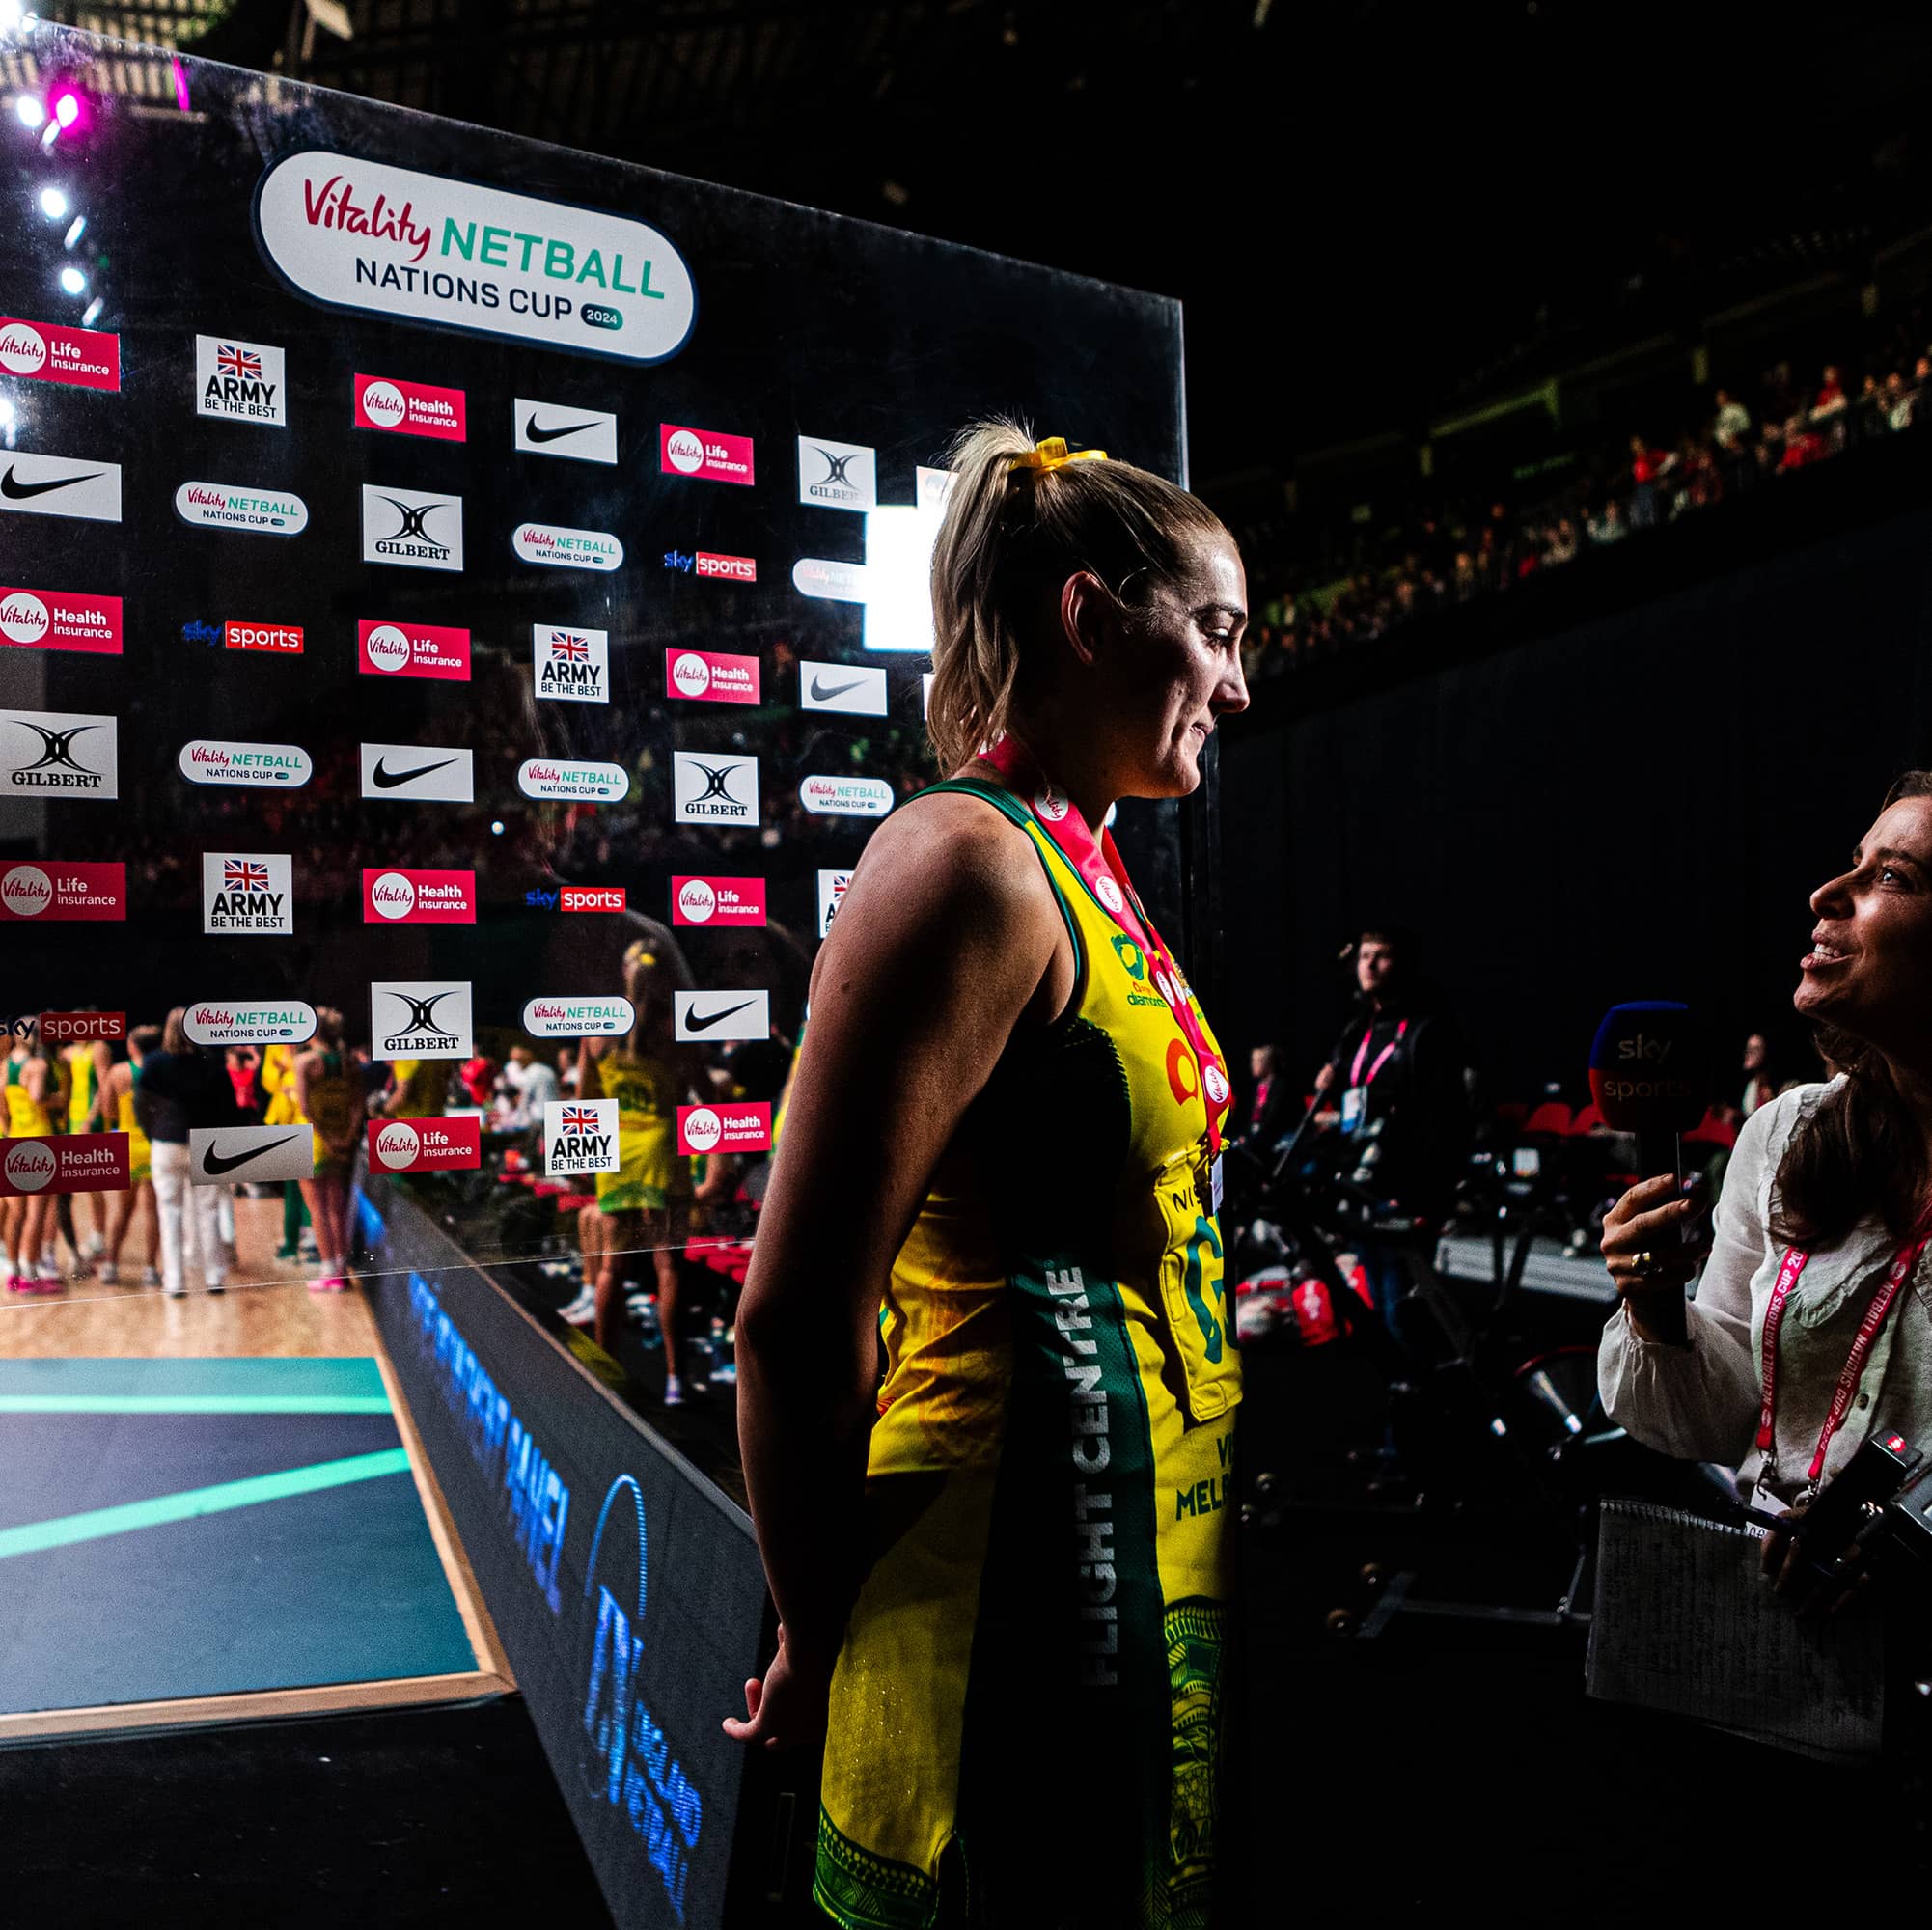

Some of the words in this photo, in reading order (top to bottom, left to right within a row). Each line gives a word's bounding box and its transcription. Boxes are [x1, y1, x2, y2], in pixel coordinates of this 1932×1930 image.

[304, 175, 430, 262] Vitality
[441, 217, 664, 299] NETBALL
[356, 258, 499, 308] NATIONS
[510, 289, 572, 319] CUP
[587, 309, 618, 325] 2024
[50, 341, 81, 358] Life
[50, 356, 109, 375] insurance
[206, 375, 276, 405] ARMY
[205, 398, 219, 410] BE
[222, 400, 245, 414] THE
[248, 404, 277, 418] BEST
[365, 392, 403, 417] Vitality
[409, 398, 453, 415] Health
[409, 411, 458, 427] insurance
[670, 440, 702, 462] Vitality
[706, 444, 728, 458] Life
[706, 457, 747, 472] insurance
[187, 487, 225, 510] Vitality
[228, 497, 298, 516] NETBALL
[810, 485, 858, 502] GILBE
[203, 510, 245, 523] NATIONS
[248, 515, 268, 524] CUP
[375, 541, 450, 560] GILBERT
[523, 529, 555, 549] Vitality
[557, 538, 615, 554] NETBALL
[536, 549, 571, 561] NATIONS
[573, 554, 591, 563] CUP
[664, 549, 694, 572] sky
[699, 557, 753, 576] sports
[0, 604, 47, 630] Vitality
[54, 608, 106, 625] Health
[54, 623, 113, 639] insurance
[183, 620, 222, 646] sky
[230, 627, 298, 648] sports
[370, 636, 408, 659] Vitality
[413, 639, 439, 653] Life
[413, 653, 462, 667] insurance
[541, 661, 600, 685] ARMY
[676, 664, 707, 683] Vitality
[712, 666, 749, 680] Health
[541, 682, 553, 693] BE
[556, 683, 575, 694] THE
[577, 685, 601, 696] BEST
[712, 678, 753, 692] insurance
[191, 746, 229, 767] Vitality
[232, 754, 302, 768] NETBALL
[11, 771, 101, 788] GILBERT
[207, 768, 250, 779] NATIONS
[252, 770, 272, 779] CUP
[528, 764, 560, 784] Vitality
[562, 771, 621, 785] NETBALL
[540, 785, 577, 794] NATIONS
[838, 786, 886, 799] NETBALL
[685, 803, 748, 816] GILBERT
[819, 799, 850, 808] NATIONS
[3, 878, 50, 902] Vitality
[57, 878, 88, 893] Life
[418, 884, 462, 898] Health
[57, 894, 116, 906] insurance
[212, 893, 284, 916] ARMY
[373, 884, 413, 907] Vitality
[418, 898, 467, 910] insurance
[525, 888, 559, 909] sky
[564, 891, 622, 910] sports
[680, 893, 713, 911] Vitality
[718, 890, 739, 903] Life
[718, 903, 759, 914] insurance
[211, 917, 226, 927] BE
[229, 917, 252, 927] THE
[256, 918, 284, 928] BEST
[196, 1007, 234, 1028] Vitality
[235, 1011, 307, 1025] NETBALL
[534, 1004, 566, 1021] Vitality
[566, 1006, 626, 1019] NETBALL
[44, 1017, 121, 1039] sports
[210, 1028, 254, 1038] NATIONS
[257, 1028, 277, 1036] CUP
[545, 1022, 583, 1031] NATIONS
[384, 1037, 459, 1051] GILBERT
[1618, 1034, 1673, 1065] sky
[1604, 1078, 1691, 1102] sports
[686, 1121, 720, 1140] Vitality
[723, 1117, 760, 1129] Health
[423, 1132, 448, 1145] Life
[723, 1128, 764, 1141] insurance
[378, 1135, 418, 1156] Vitality
[423, 1146, 472, 1157] insurance
[553, 1135, 611, 1158] ARMY
[6, 1153, 55, 1178] Vitality
[62, 1149, 114, 1165] Health
[551, 1159, 565, 1170] BE
[566, 1158, 585, 1170] THE
[588, 1156, 612, 1168] BEST
[62, 1165, 120, 1177] insurance
[1787, 1251, 1805, 1269] 20
[1778, 1267, 1794, 1294] CUP
[1864, 1282, 1894, 1333] NETBALL
[1763, 1296, 1782, 1349] NATIONS
[1839, 1333, 1869, 1388] NATIONS
[1045, 1266, 1111, 1475] CENTRE
[1762, 1354, 1774, 1406] NETBALL
[1832, 1387, 1846, 1416] CUP
[1217, 1433, 1235, 1467] VI
[1076, 1483, 1118, 1687] FLIGHT
